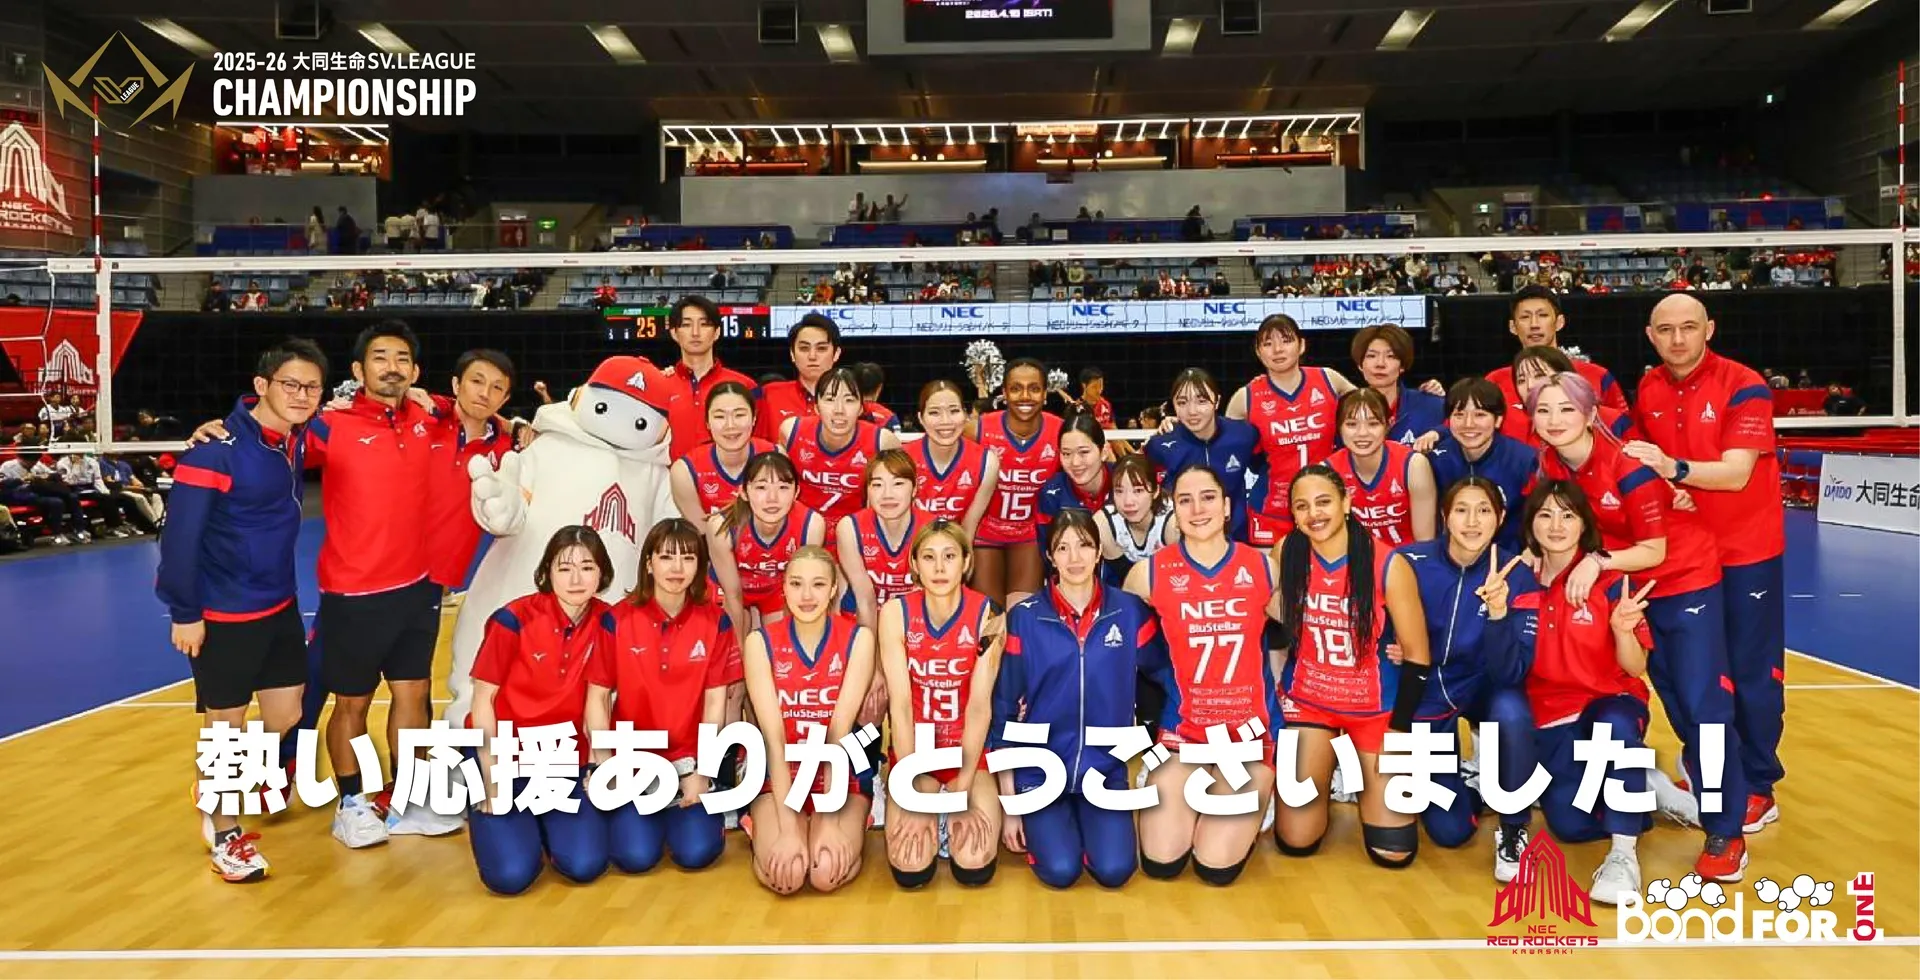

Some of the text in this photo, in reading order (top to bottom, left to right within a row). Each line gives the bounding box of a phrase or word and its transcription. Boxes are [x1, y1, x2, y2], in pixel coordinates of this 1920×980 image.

[941, 307, 984, 318] NEC
[1072, 304, 1115, 316] NEC
[1204, 303, 1246, 314] NEC
[1336, 300, 1379, 312] NEC
[636, 316, 657, 338] 25
[721, 315, 739, 337] 15
[1270, 412, 1327, 436] NEC
[802, 469, 860, 488] NEC
[999, 468, 1047, 484] NEC
[819, 490, 842, 511] 7
[914, 496, 965, 512] NEC
[1000, 491, 1035, 520] 15
[1351, 502, 1407, 519] NEC
[1181, 597, 1248, 620] NEC
[1307, 626, 1356, 668] 19
[908, 656, 970, 677] NEC
[1189, 633, 1245, 685] 77
[778, 685, 840, 707] NEC
[920, 686, 959, 722] 13
